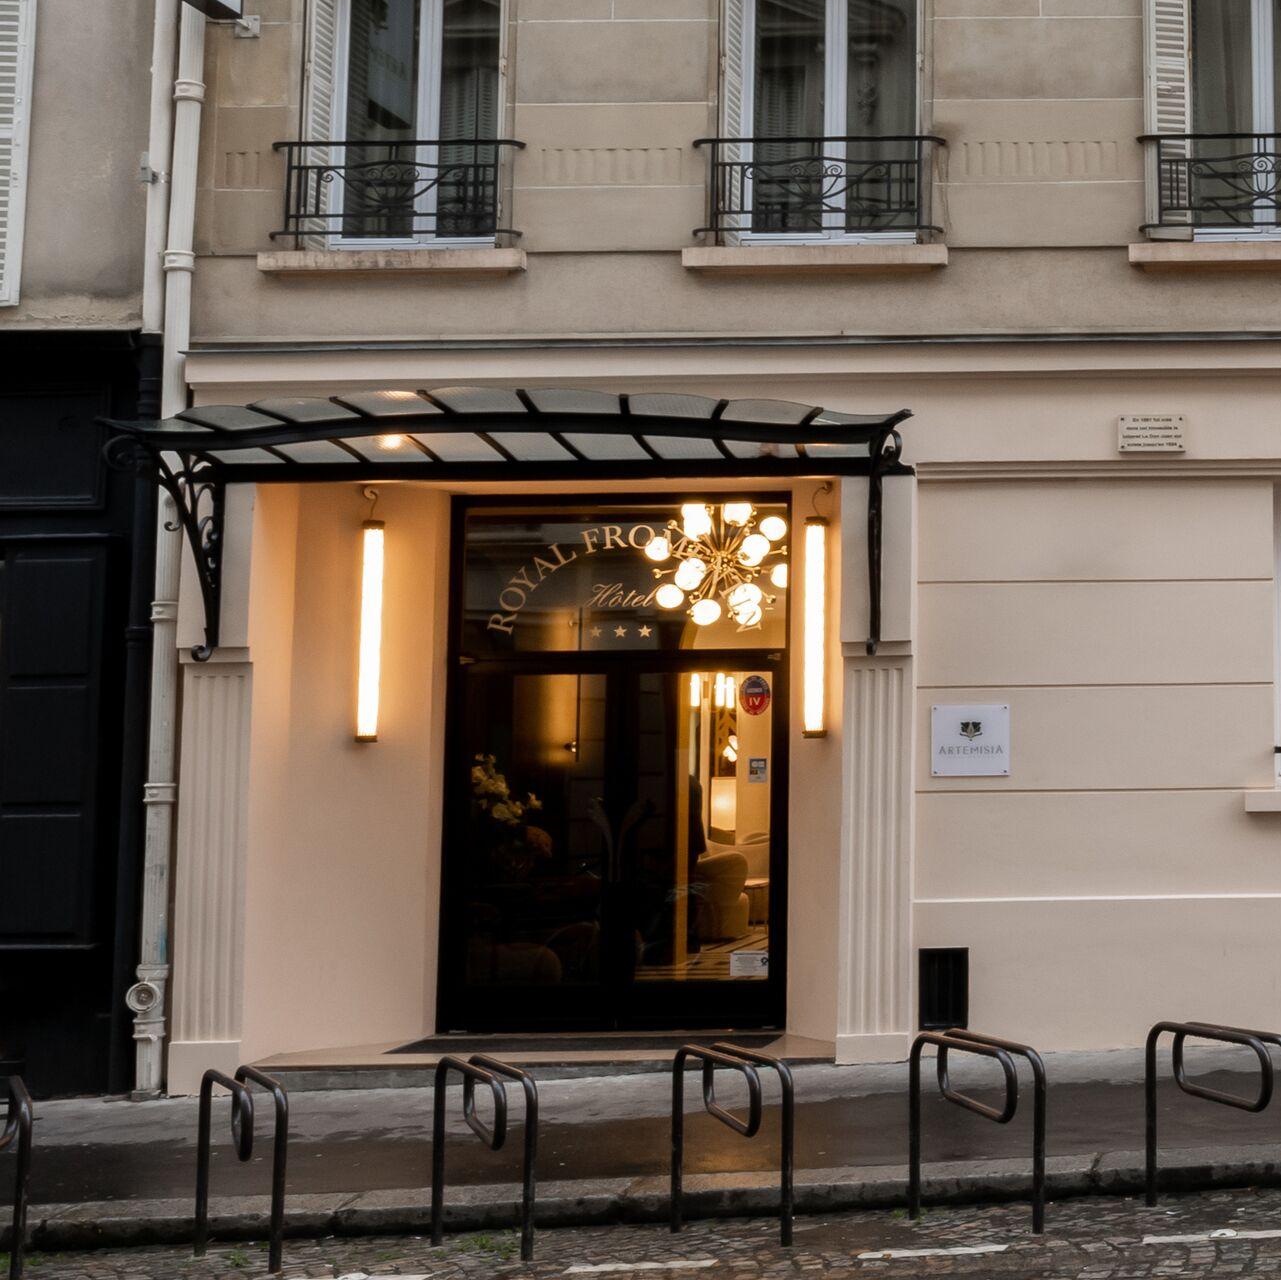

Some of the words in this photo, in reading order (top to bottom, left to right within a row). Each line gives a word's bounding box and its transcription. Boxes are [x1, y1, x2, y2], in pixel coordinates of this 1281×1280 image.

[487, 543, 577, 636] ROYAL
[584, 582, 667, 608] Hôtel
[939, 744, 1004, 755] ARTEMISIA
